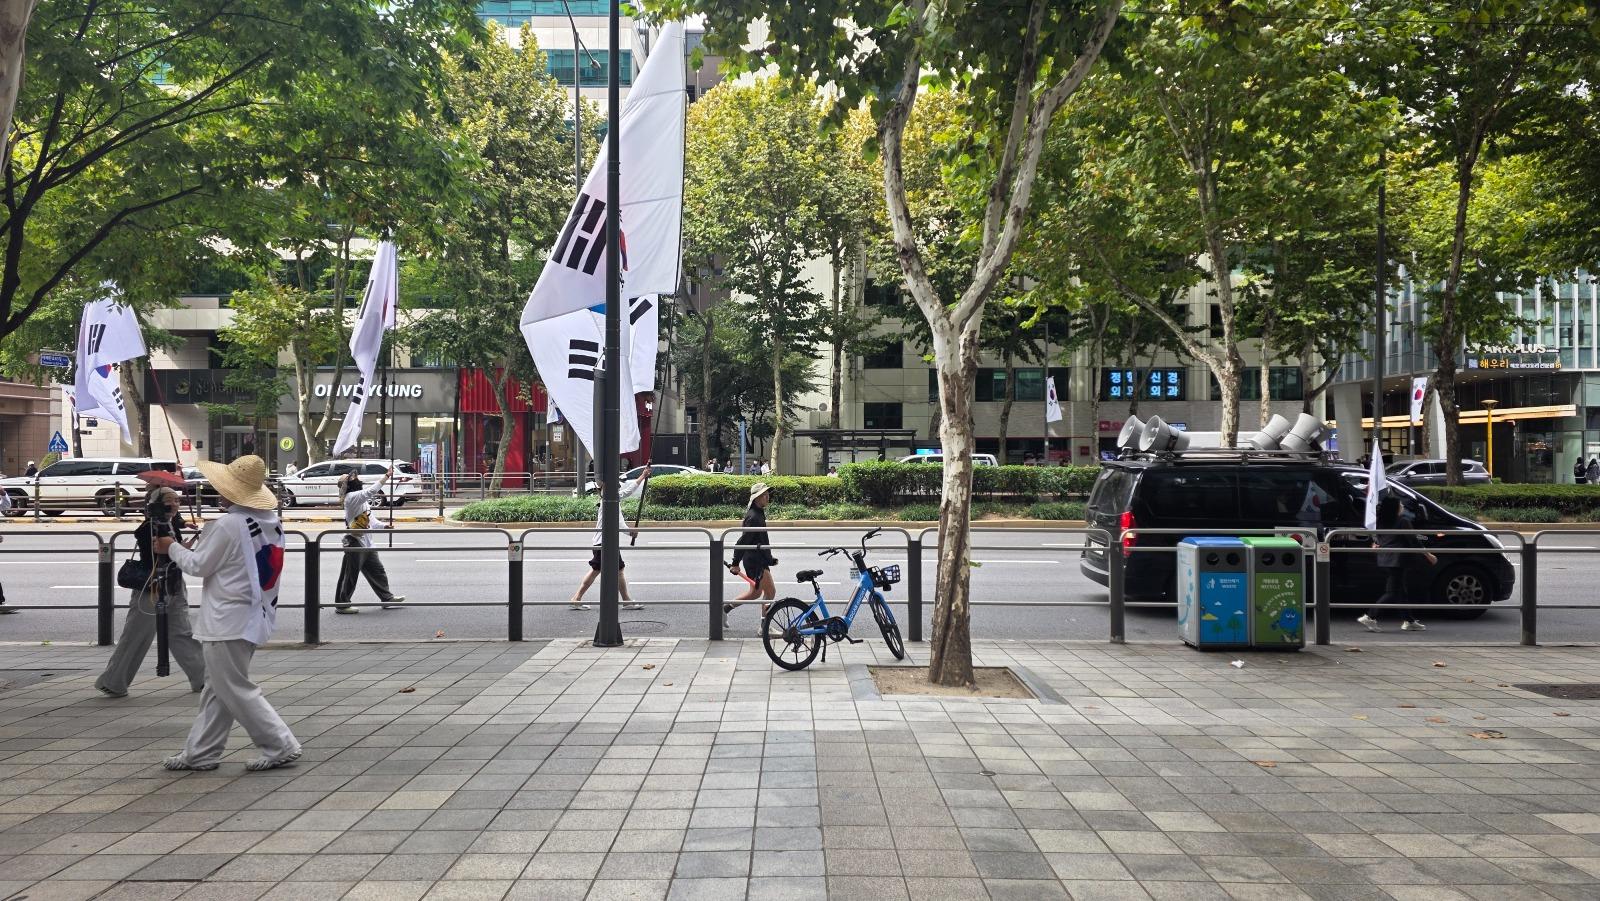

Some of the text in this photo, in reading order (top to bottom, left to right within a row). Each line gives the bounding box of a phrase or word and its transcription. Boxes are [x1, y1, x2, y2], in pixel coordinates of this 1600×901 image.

[1479, 359, 1509, 369] 해우리
[1150, 372, 1178, 384] 신경
[1150, 385, 1179, 397] 외과
